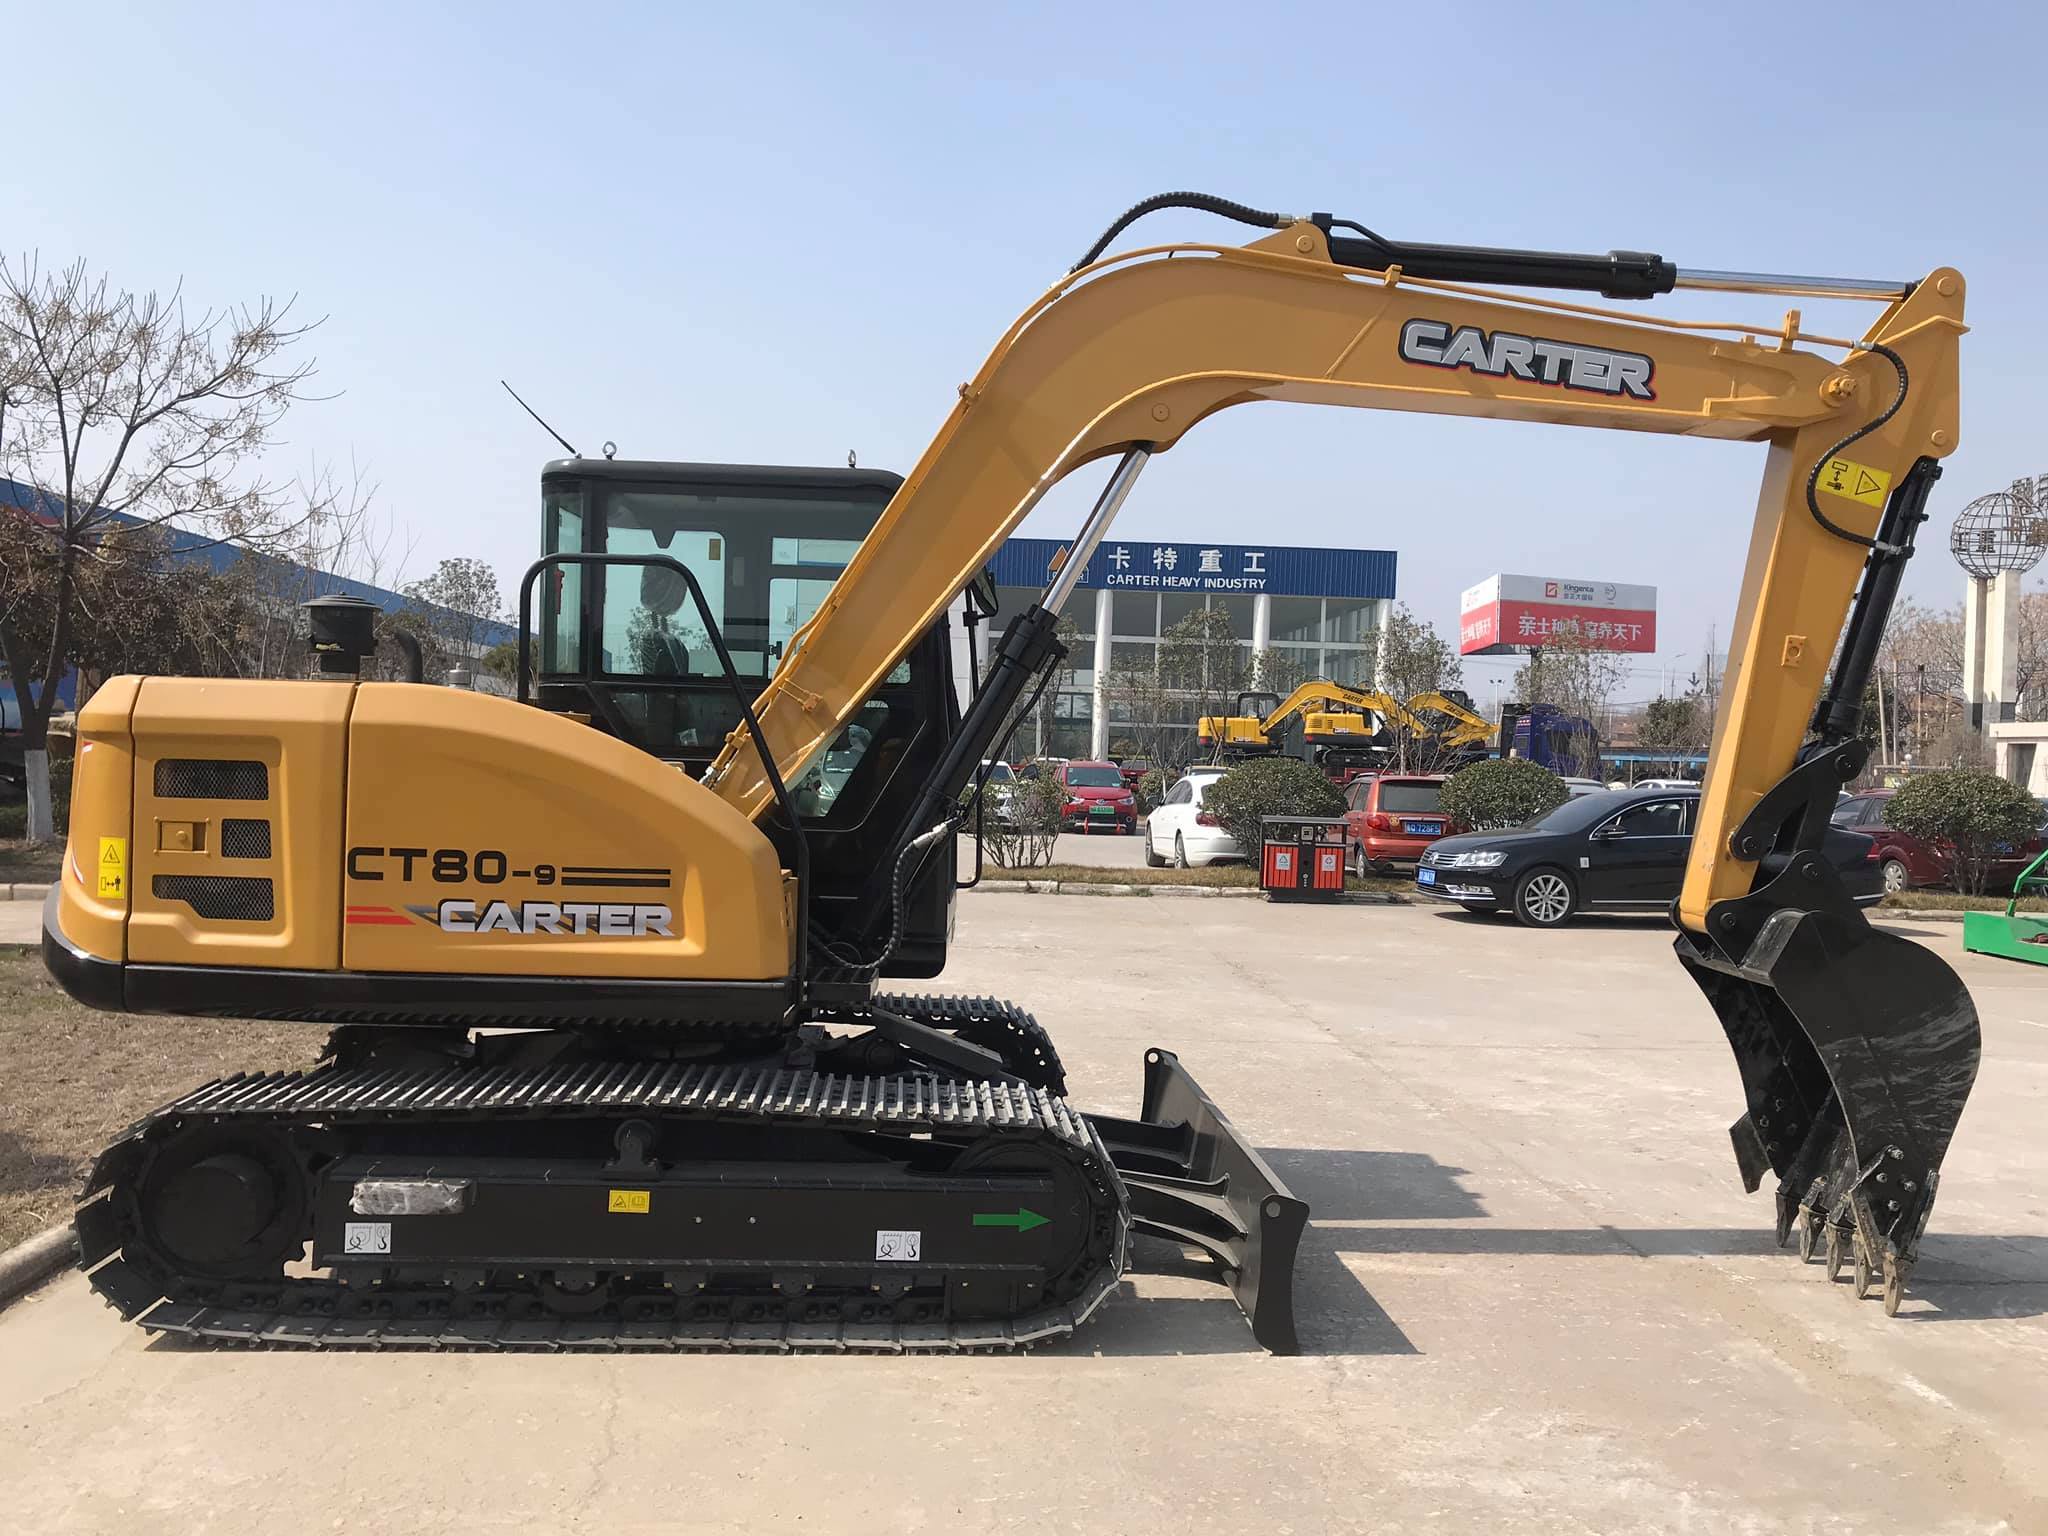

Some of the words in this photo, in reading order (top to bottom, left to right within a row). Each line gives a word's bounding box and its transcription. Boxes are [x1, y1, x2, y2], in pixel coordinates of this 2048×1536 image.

[1399, 319, 1656, 399] CARTER
[1108, 546, 1266, 573] 卡特重工
[1107, 574, 1160, 586] CARTER
[1162, 576, 1201, 588] HEAVY
[1204, 577, 1267, 589] INDUSTRY
[347, 847, 555, 885] CT80-9
[438, 898, 674, 936] CARTER
